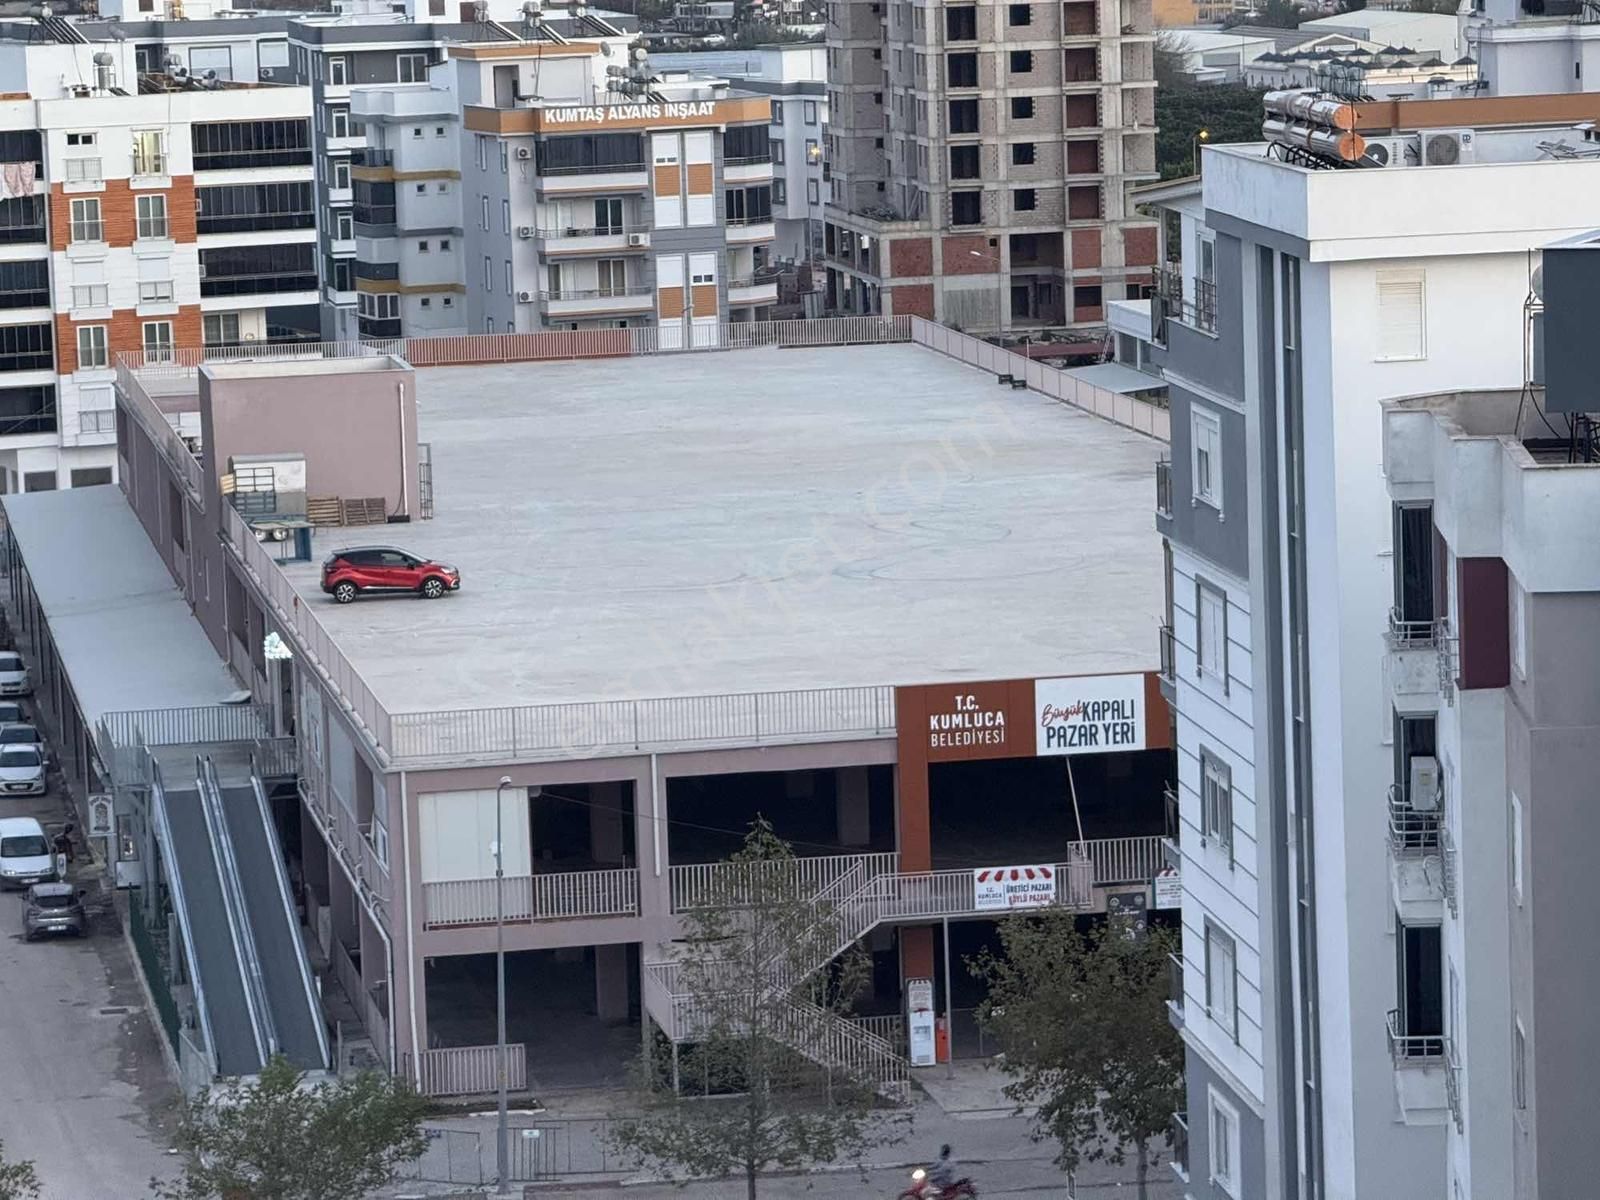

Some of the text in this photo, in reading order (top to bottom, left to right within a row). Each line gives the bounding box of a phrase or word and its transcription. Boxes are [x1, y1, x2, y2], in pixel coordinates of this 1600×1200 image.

[545, 107, 604, 124] KUMTAŞ
[608, 104, 661, 121] ALYANS
[956, 695, 979, 711] T.C.
[1082, 699, 1135, 722] KAPALI
[930, 711, 1005, 730] KUMLUCA
[930, 727, 1005, 748] BELEDİYESİ
[1046, 724, 1099, 748] PAZAR
